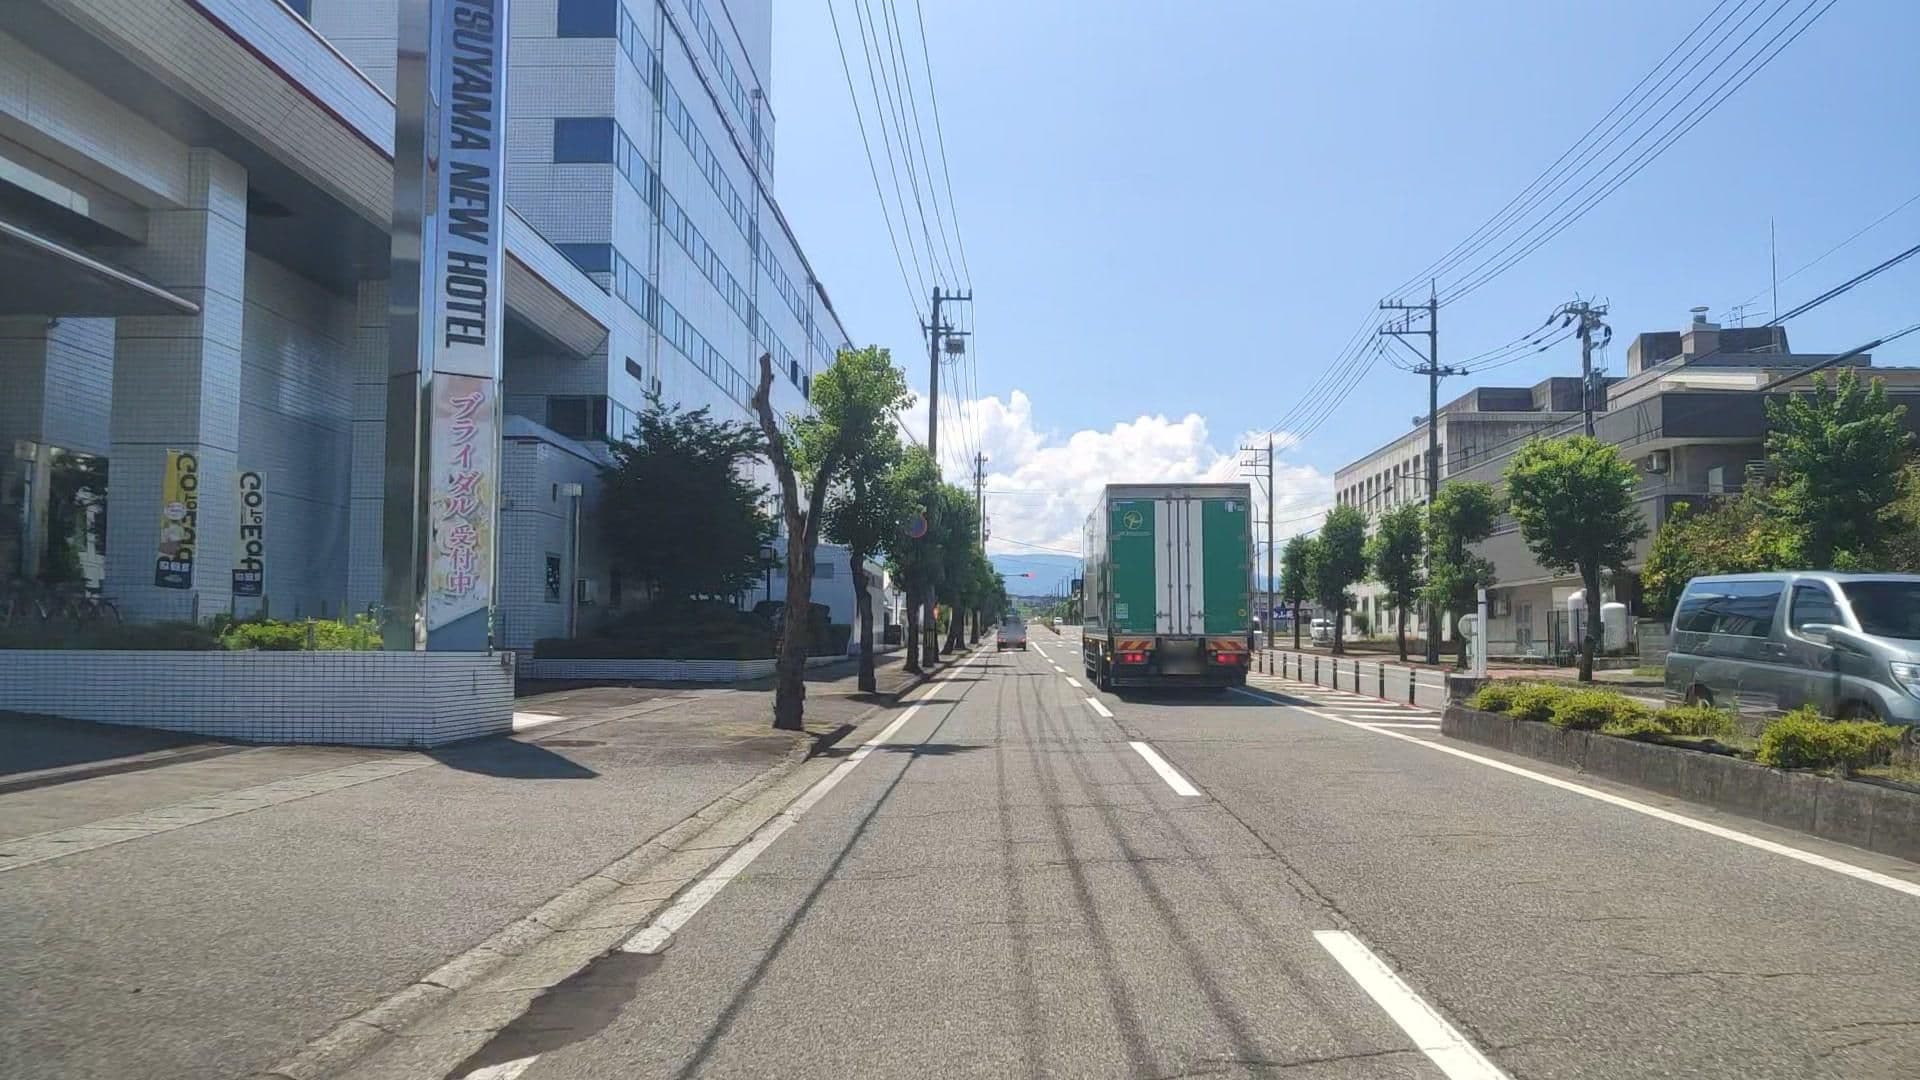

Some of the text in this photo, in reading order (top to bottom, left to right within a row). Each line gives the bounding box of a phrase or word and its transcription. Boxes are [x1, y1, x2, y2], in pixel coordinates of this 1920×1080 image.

[448, 161, 490, 246] NEW
[445, 250, 488, 348] HOTEL
[443, 391, 484, 593] ブライダル受付中
